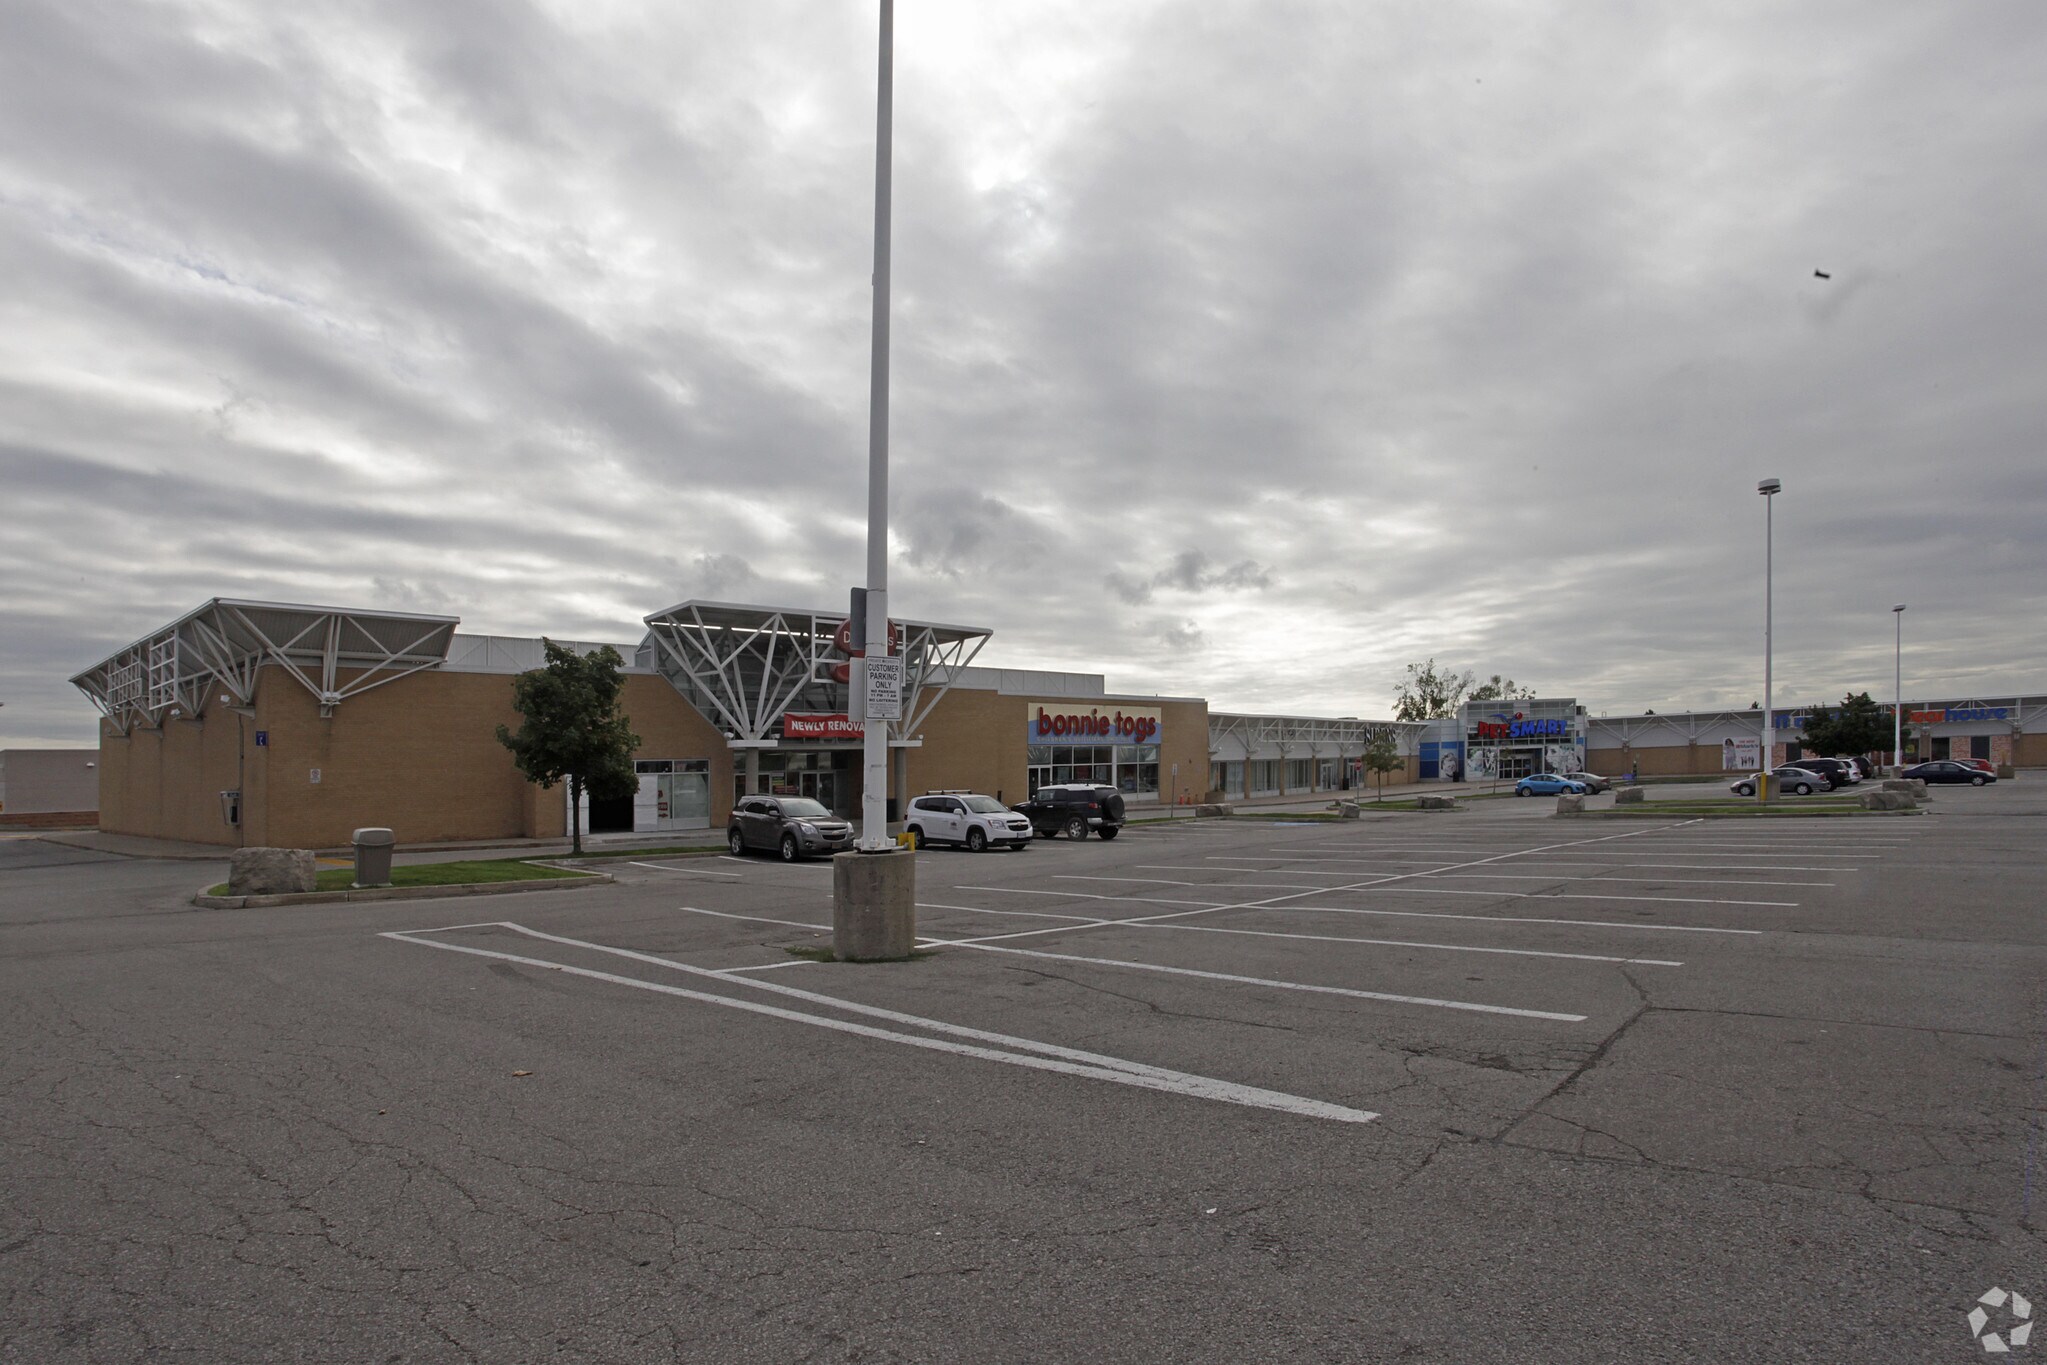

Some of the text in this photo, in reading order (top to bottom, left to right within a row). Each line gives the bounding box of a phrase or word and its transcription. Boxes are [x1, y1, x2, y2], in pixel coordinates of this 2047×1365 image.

[868, 664, 899, 672] CUSTOMER
[870, 672, 897, 681] PARKING
[875, 681, 892, 689] ONLY
[1891, 707, 2008, 723] earhouse
[791, 720, 865, 731] NEWLY RENOVA
[1037, 706, 1156, 743] bonnie togs
